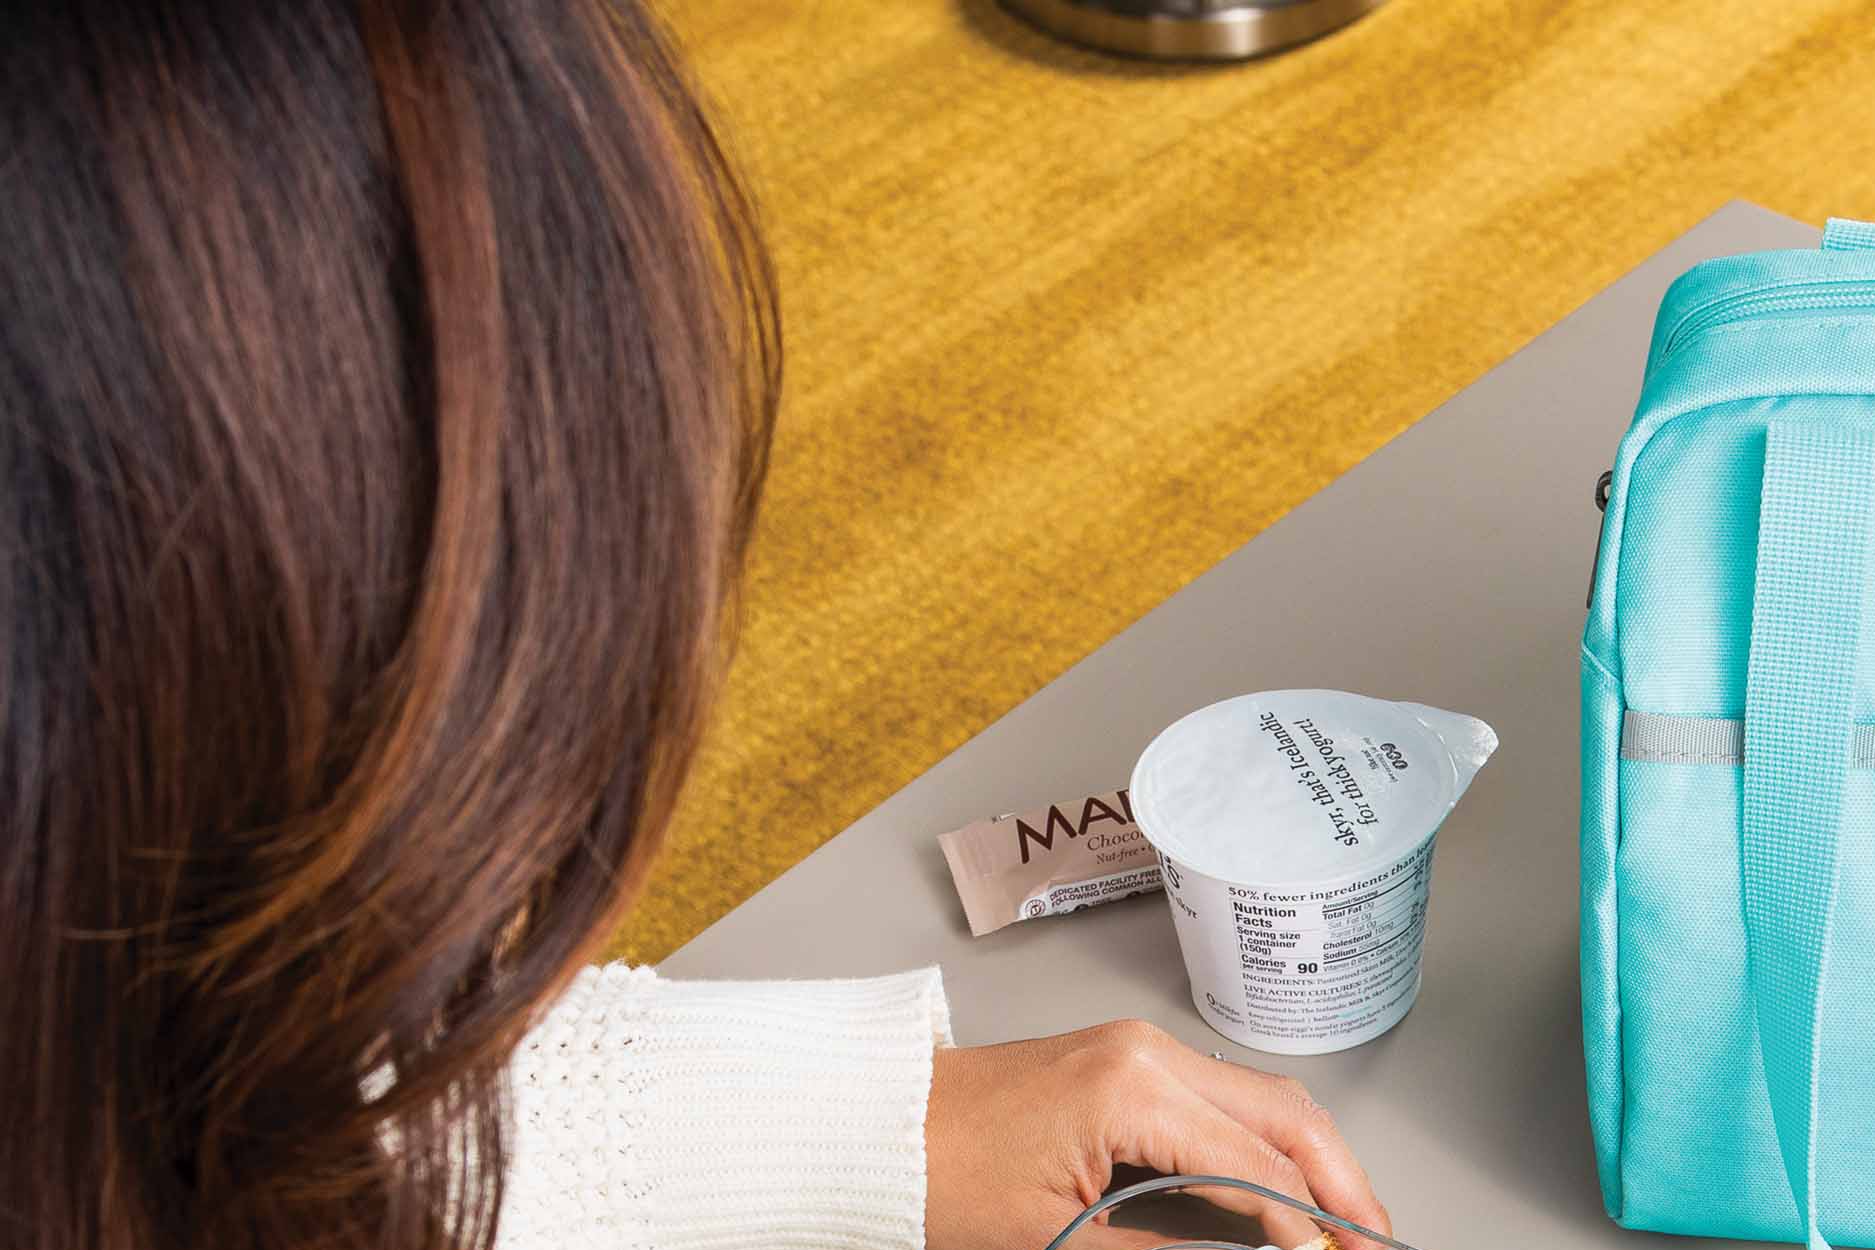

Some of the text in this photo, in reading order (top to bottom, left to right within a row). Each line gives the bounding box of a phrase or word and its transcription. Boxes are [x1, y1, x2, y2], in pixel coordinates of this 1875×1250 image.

[1259, 712, 1309, 771] Icelandic
[1292, 718, 1379, 825] for thick yogurt!
[1328, 807, 1359, 847] skyr,
[1096, 848, 1140, 865] Nut-free
[1050, 883, 1097, 901] DEDICATED
[1099, 874, 1138, 890] FACILITY
[1228, 886, 1259, 900] 50%
[1263, 891, 1306, 902] fewer
[1309, 871, 1389, 900] ingredients
[1391, 856, 1415, 876] than
[1051, 888, 1100, 908] FOLLOWING
[1102, 880, 1145, 894] COMMON
[1233, 901, 1297, 918] Nutrition
[1323, 910, 1346, 921] Total
[1347, 904, 1362, 916] Fat
[1235, 913, 1273, 928] Facts
[1236, 926, 1301, 940] Serving size
[1323, 931, 1373, 950] Cholesterol
[1240, 942, 1272, 955] (150g)
[1247, 936, 1297, 948] container
[1323, 948, 1357, 961] Sodium
[1241, 954, 1318, 974] Calories 90
[1256, 966, 1283, 974] serving
[1244, 984, 1267, 994] LIVE
[1269, 989, 1304, 997] ACTIVE
